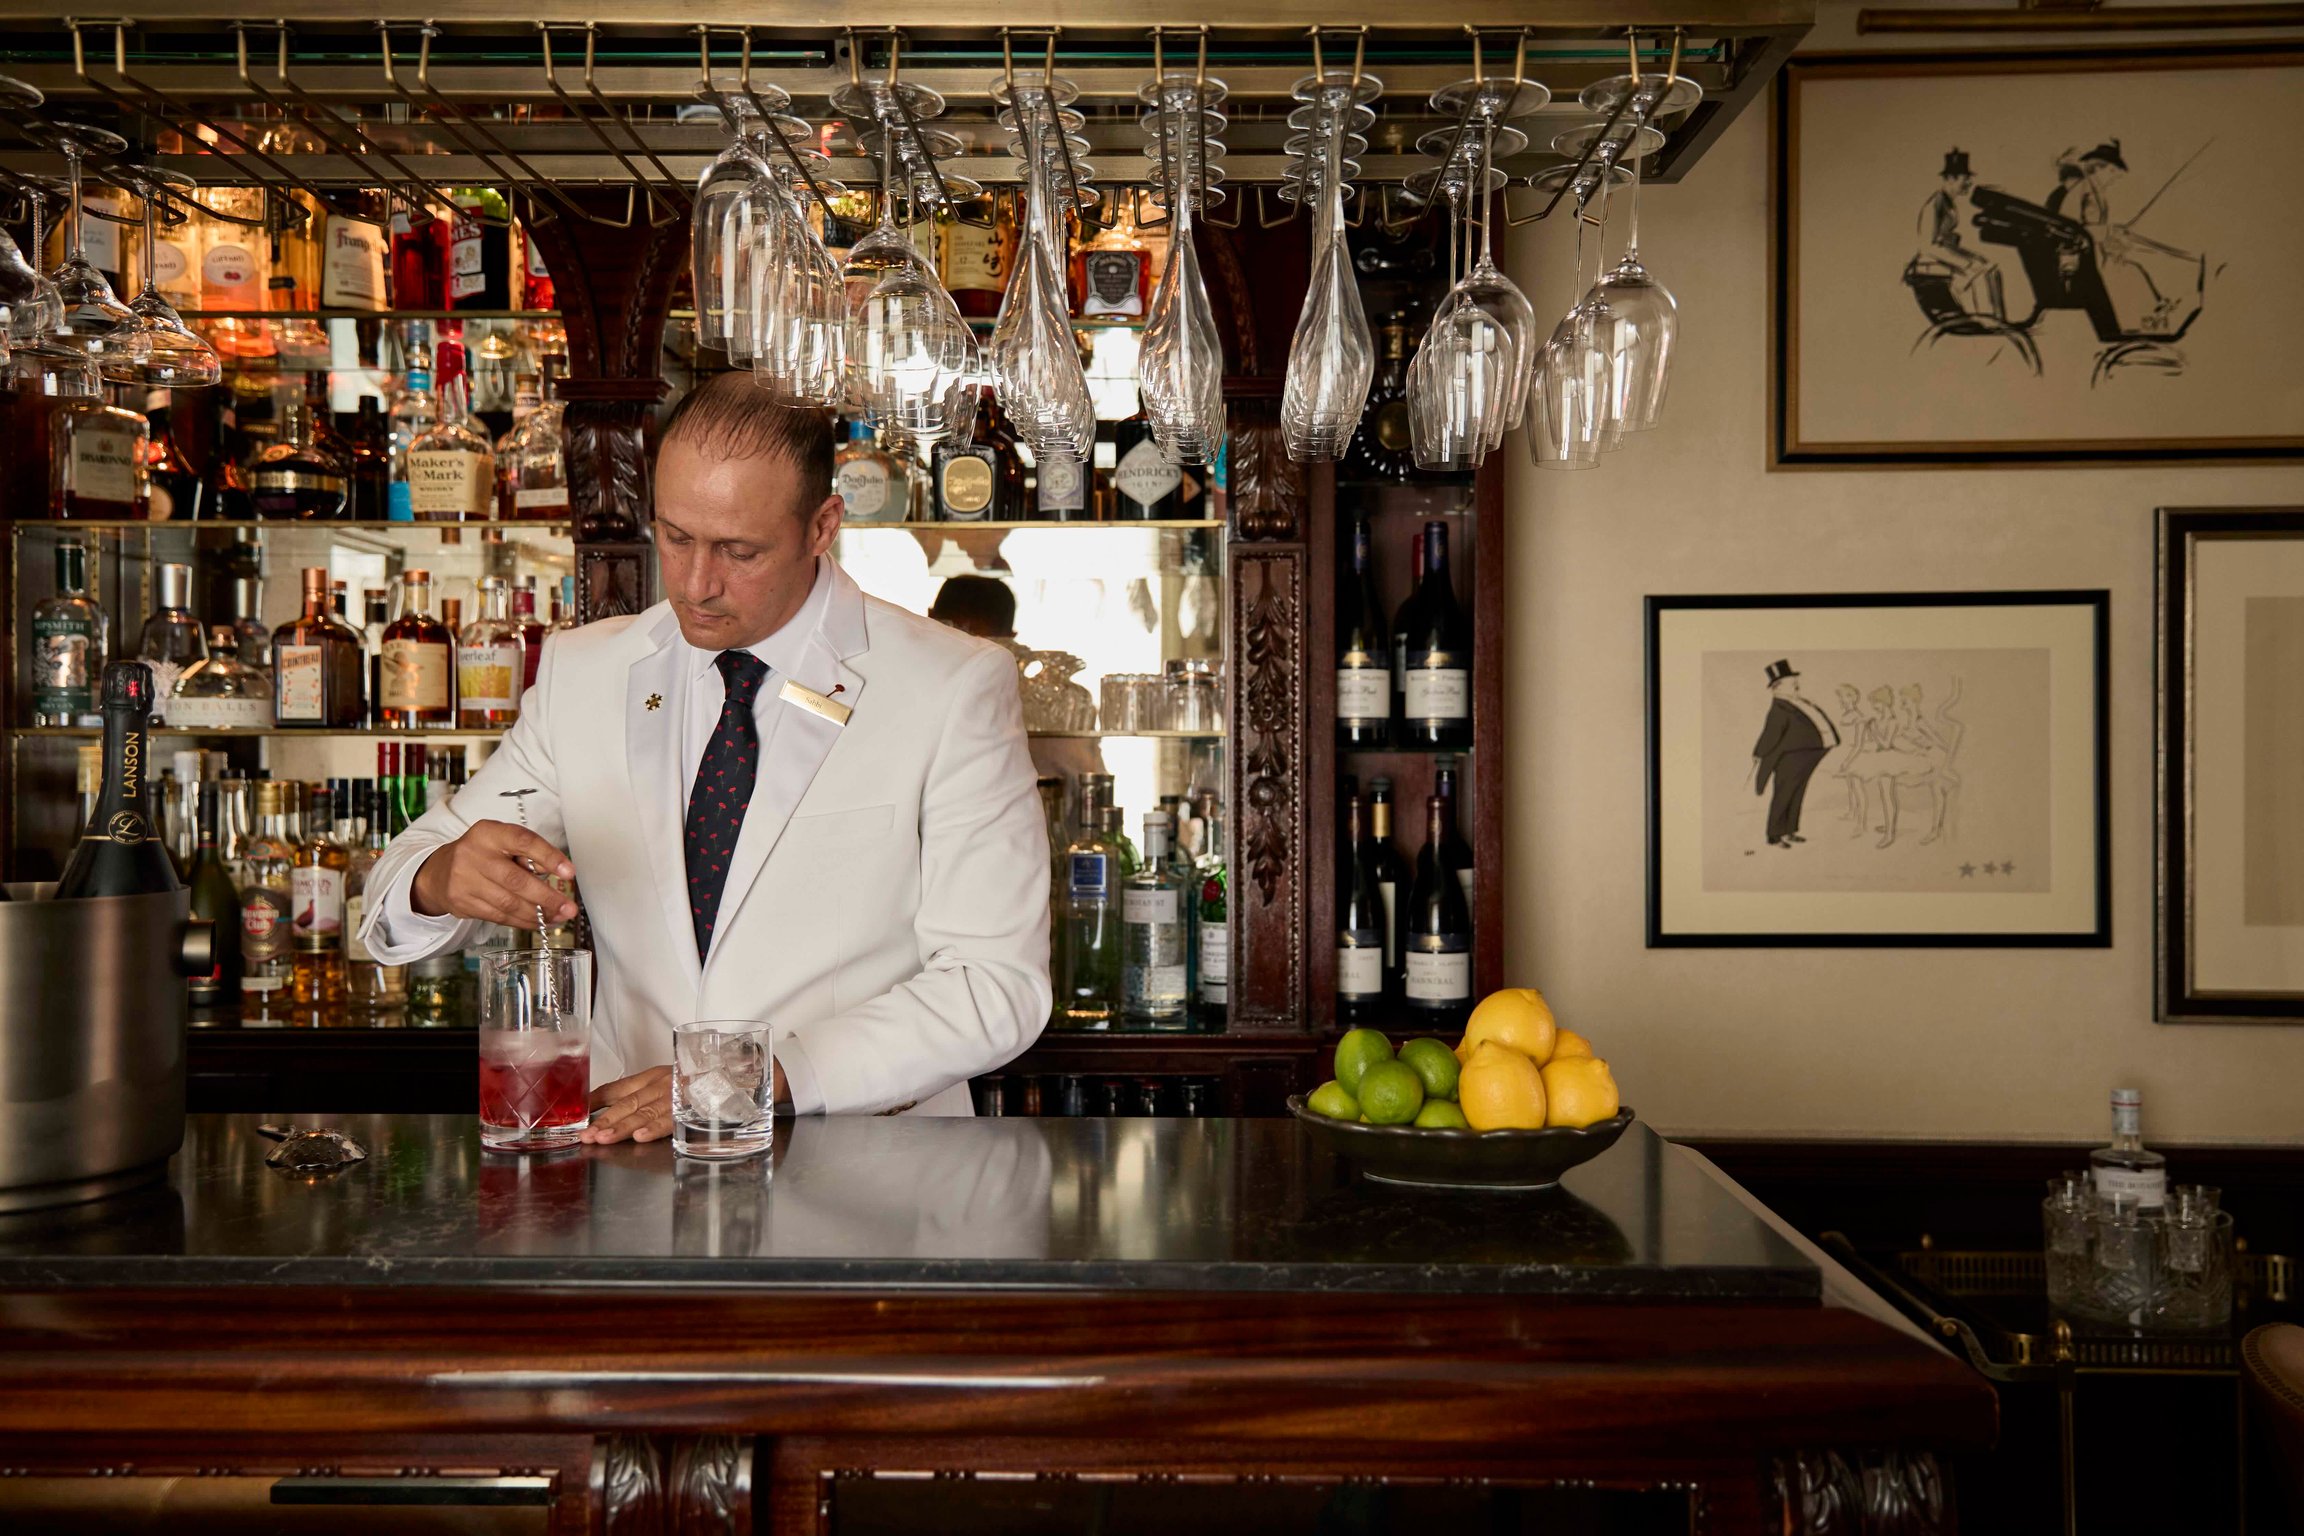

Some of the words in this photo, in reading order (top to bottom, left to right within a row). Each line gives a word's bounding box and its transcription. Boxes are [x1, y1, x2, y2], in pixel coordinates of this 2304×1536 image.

[410, 457, 465, 469] Maker's
[424, 469, 464, 481] Mark
[460, 650, 496, 662] verleaf
[123, 732, 140, 798] LANSON
